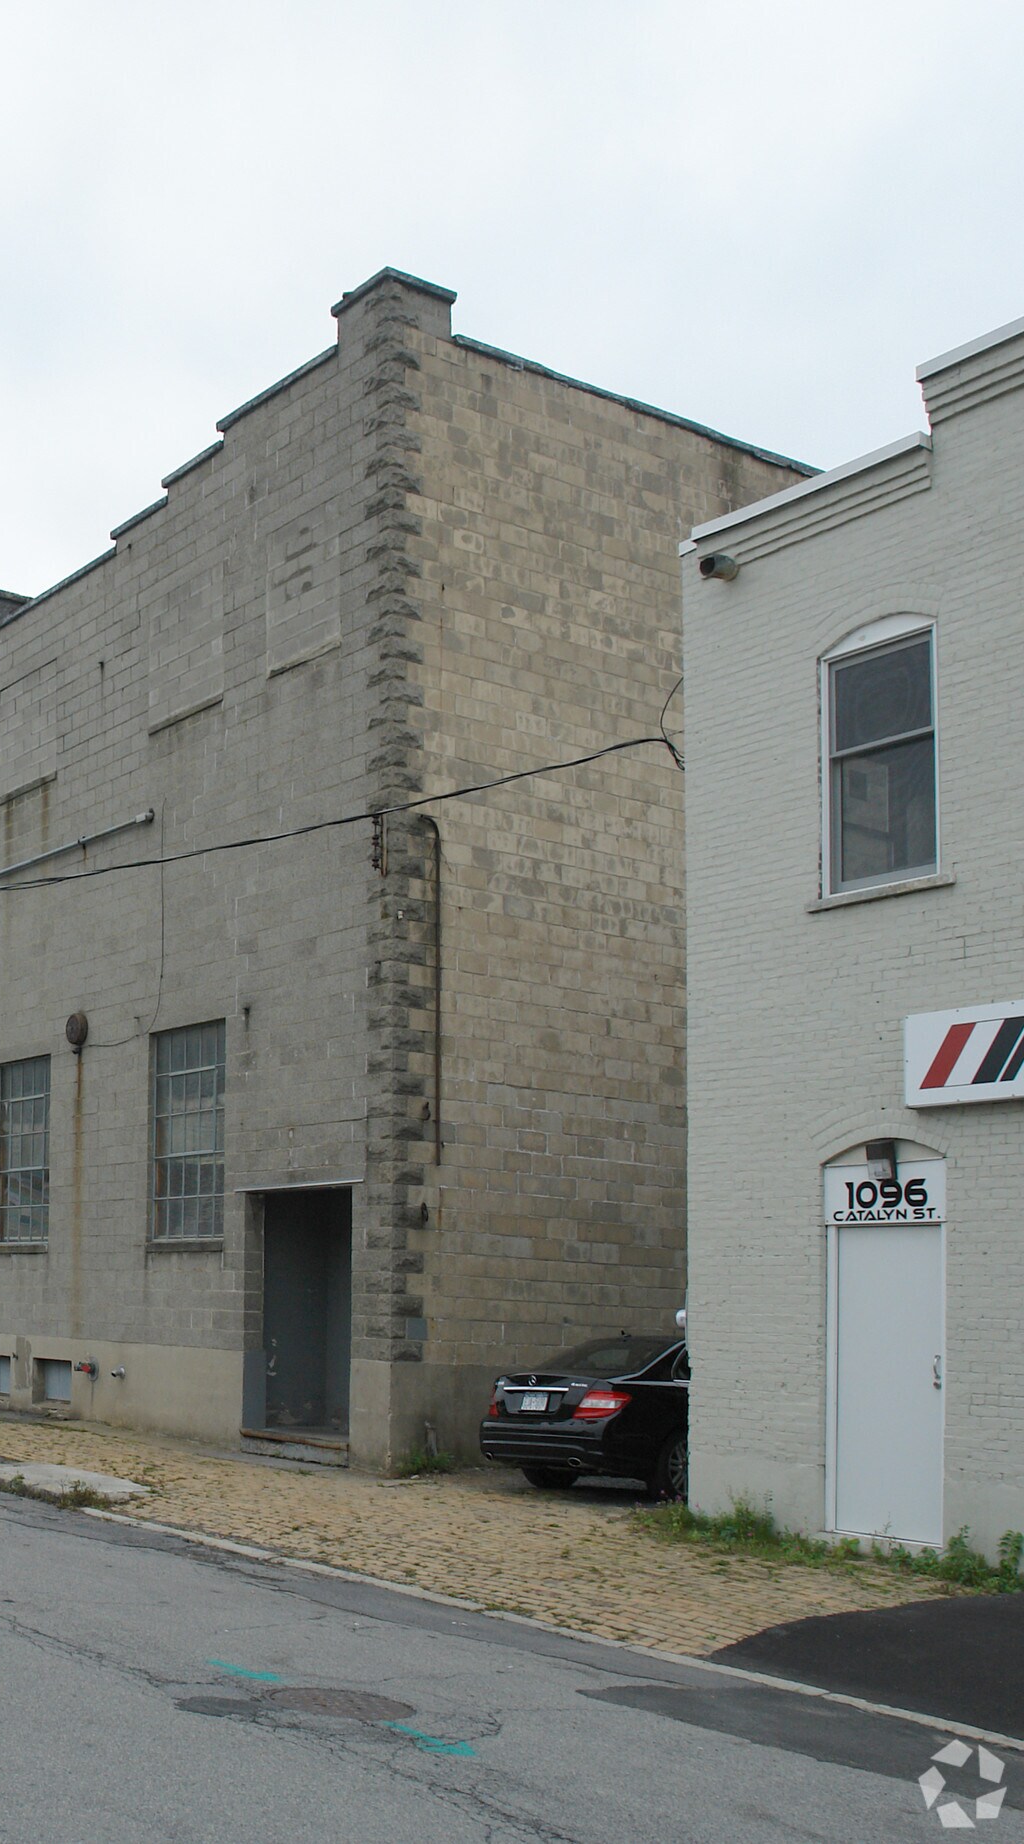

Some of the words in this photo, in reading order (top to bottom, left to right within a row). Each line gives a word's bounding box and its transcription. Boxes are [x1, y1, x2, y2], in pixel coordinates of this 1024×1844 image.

[845, 1178, 927, 1209] 1096
[833, 1209, 907, 1221] CATALYN
[913, 1208, 941, 1219] ST.
